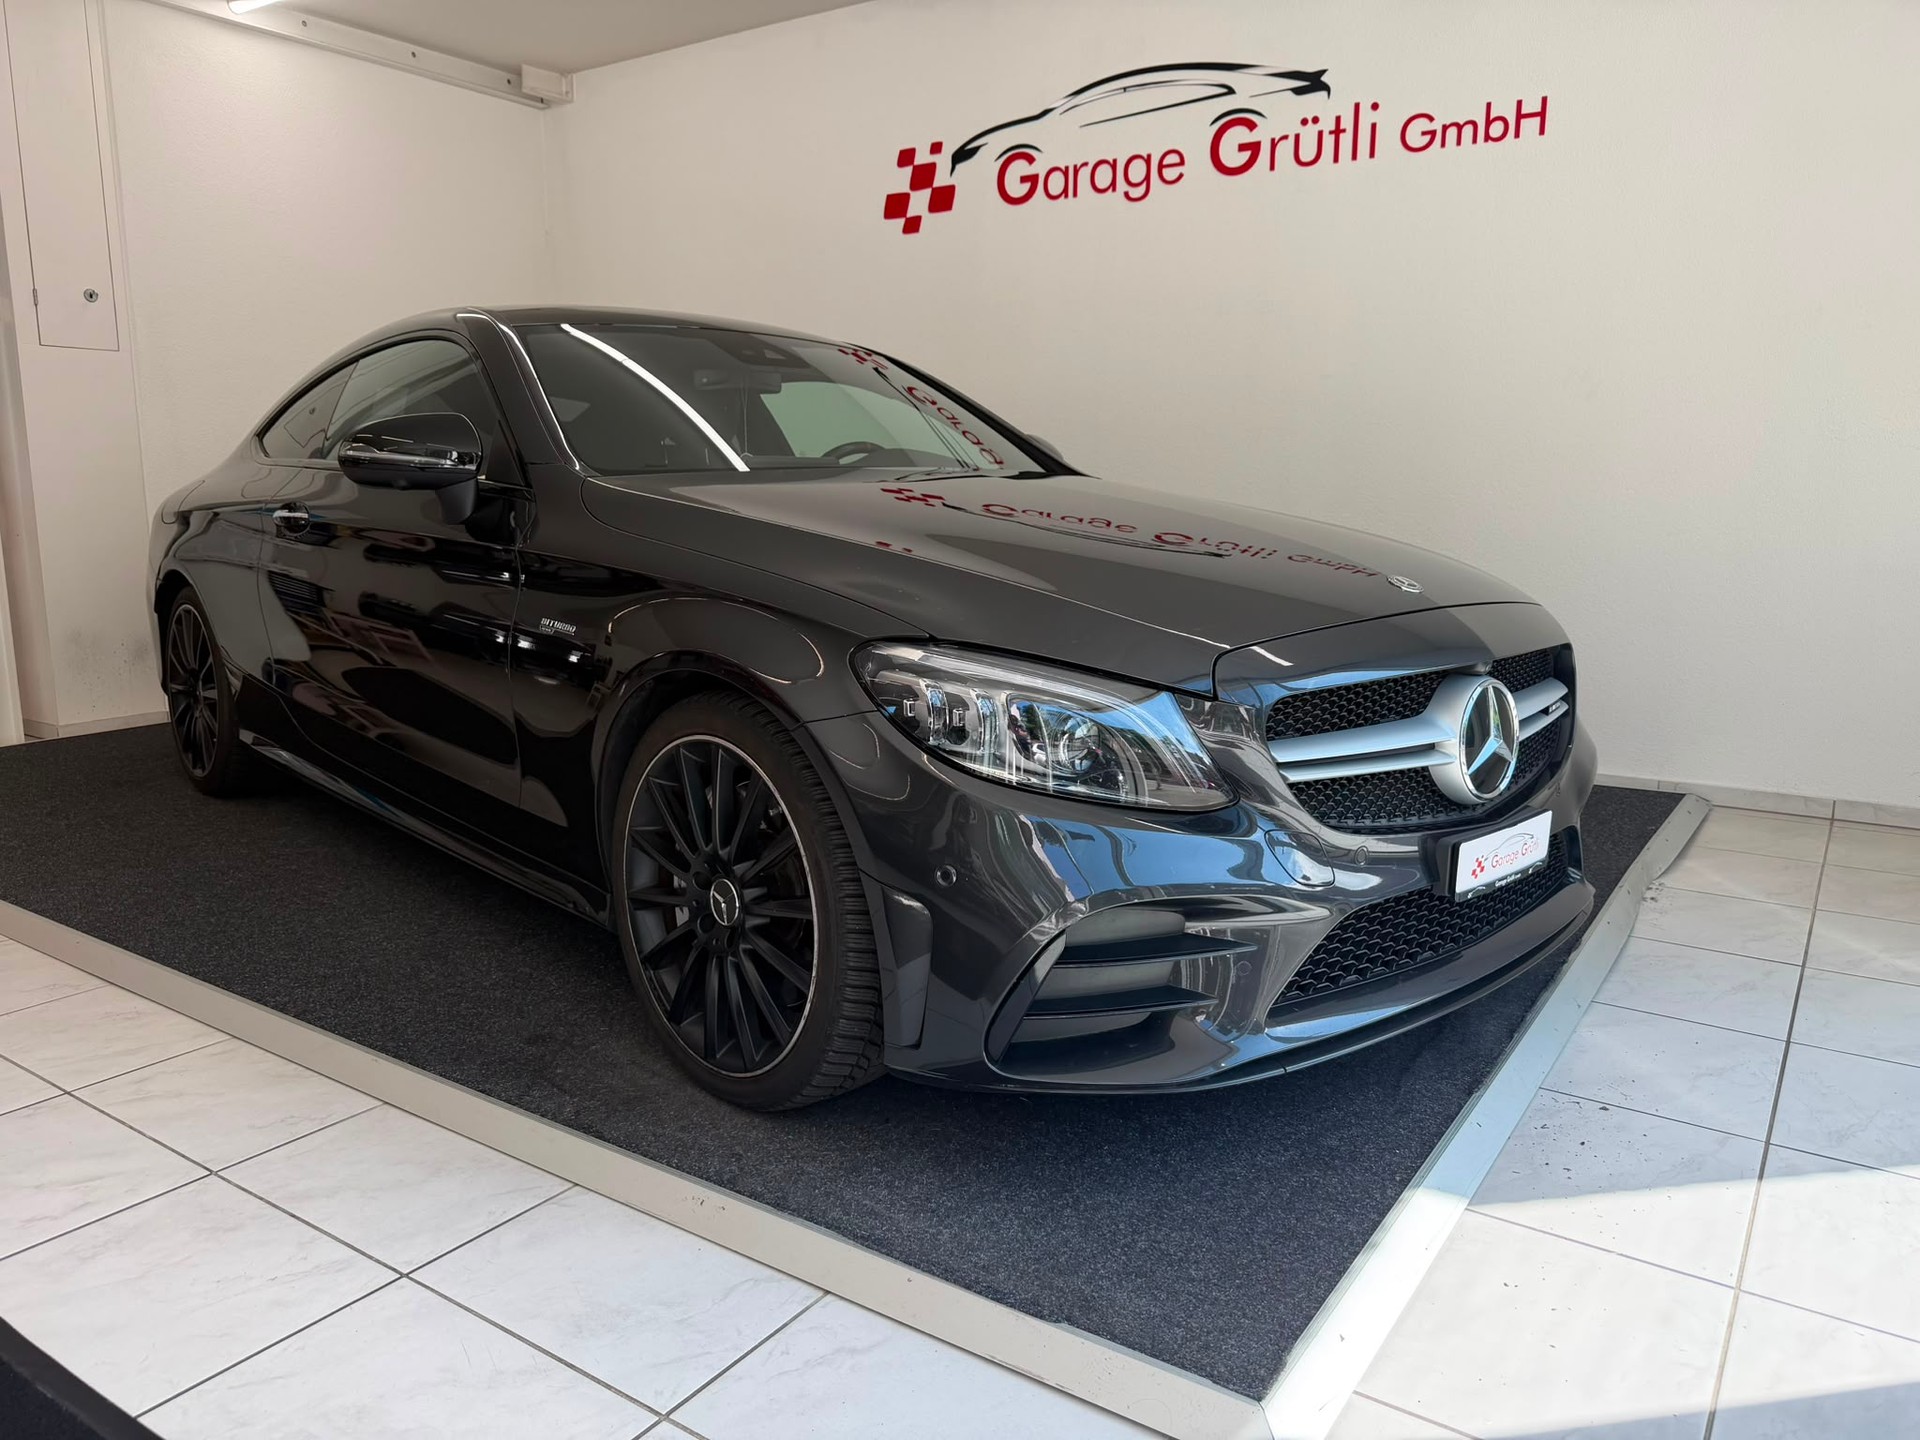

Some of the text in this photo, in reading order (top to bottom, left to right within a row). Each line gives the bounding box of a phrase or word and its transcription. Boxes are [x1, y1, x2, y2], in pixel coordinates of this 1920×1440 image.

[997, 96, 1548, 206] Garage Grütli GmbH
[1491, 850, 1519, 868] Garage
